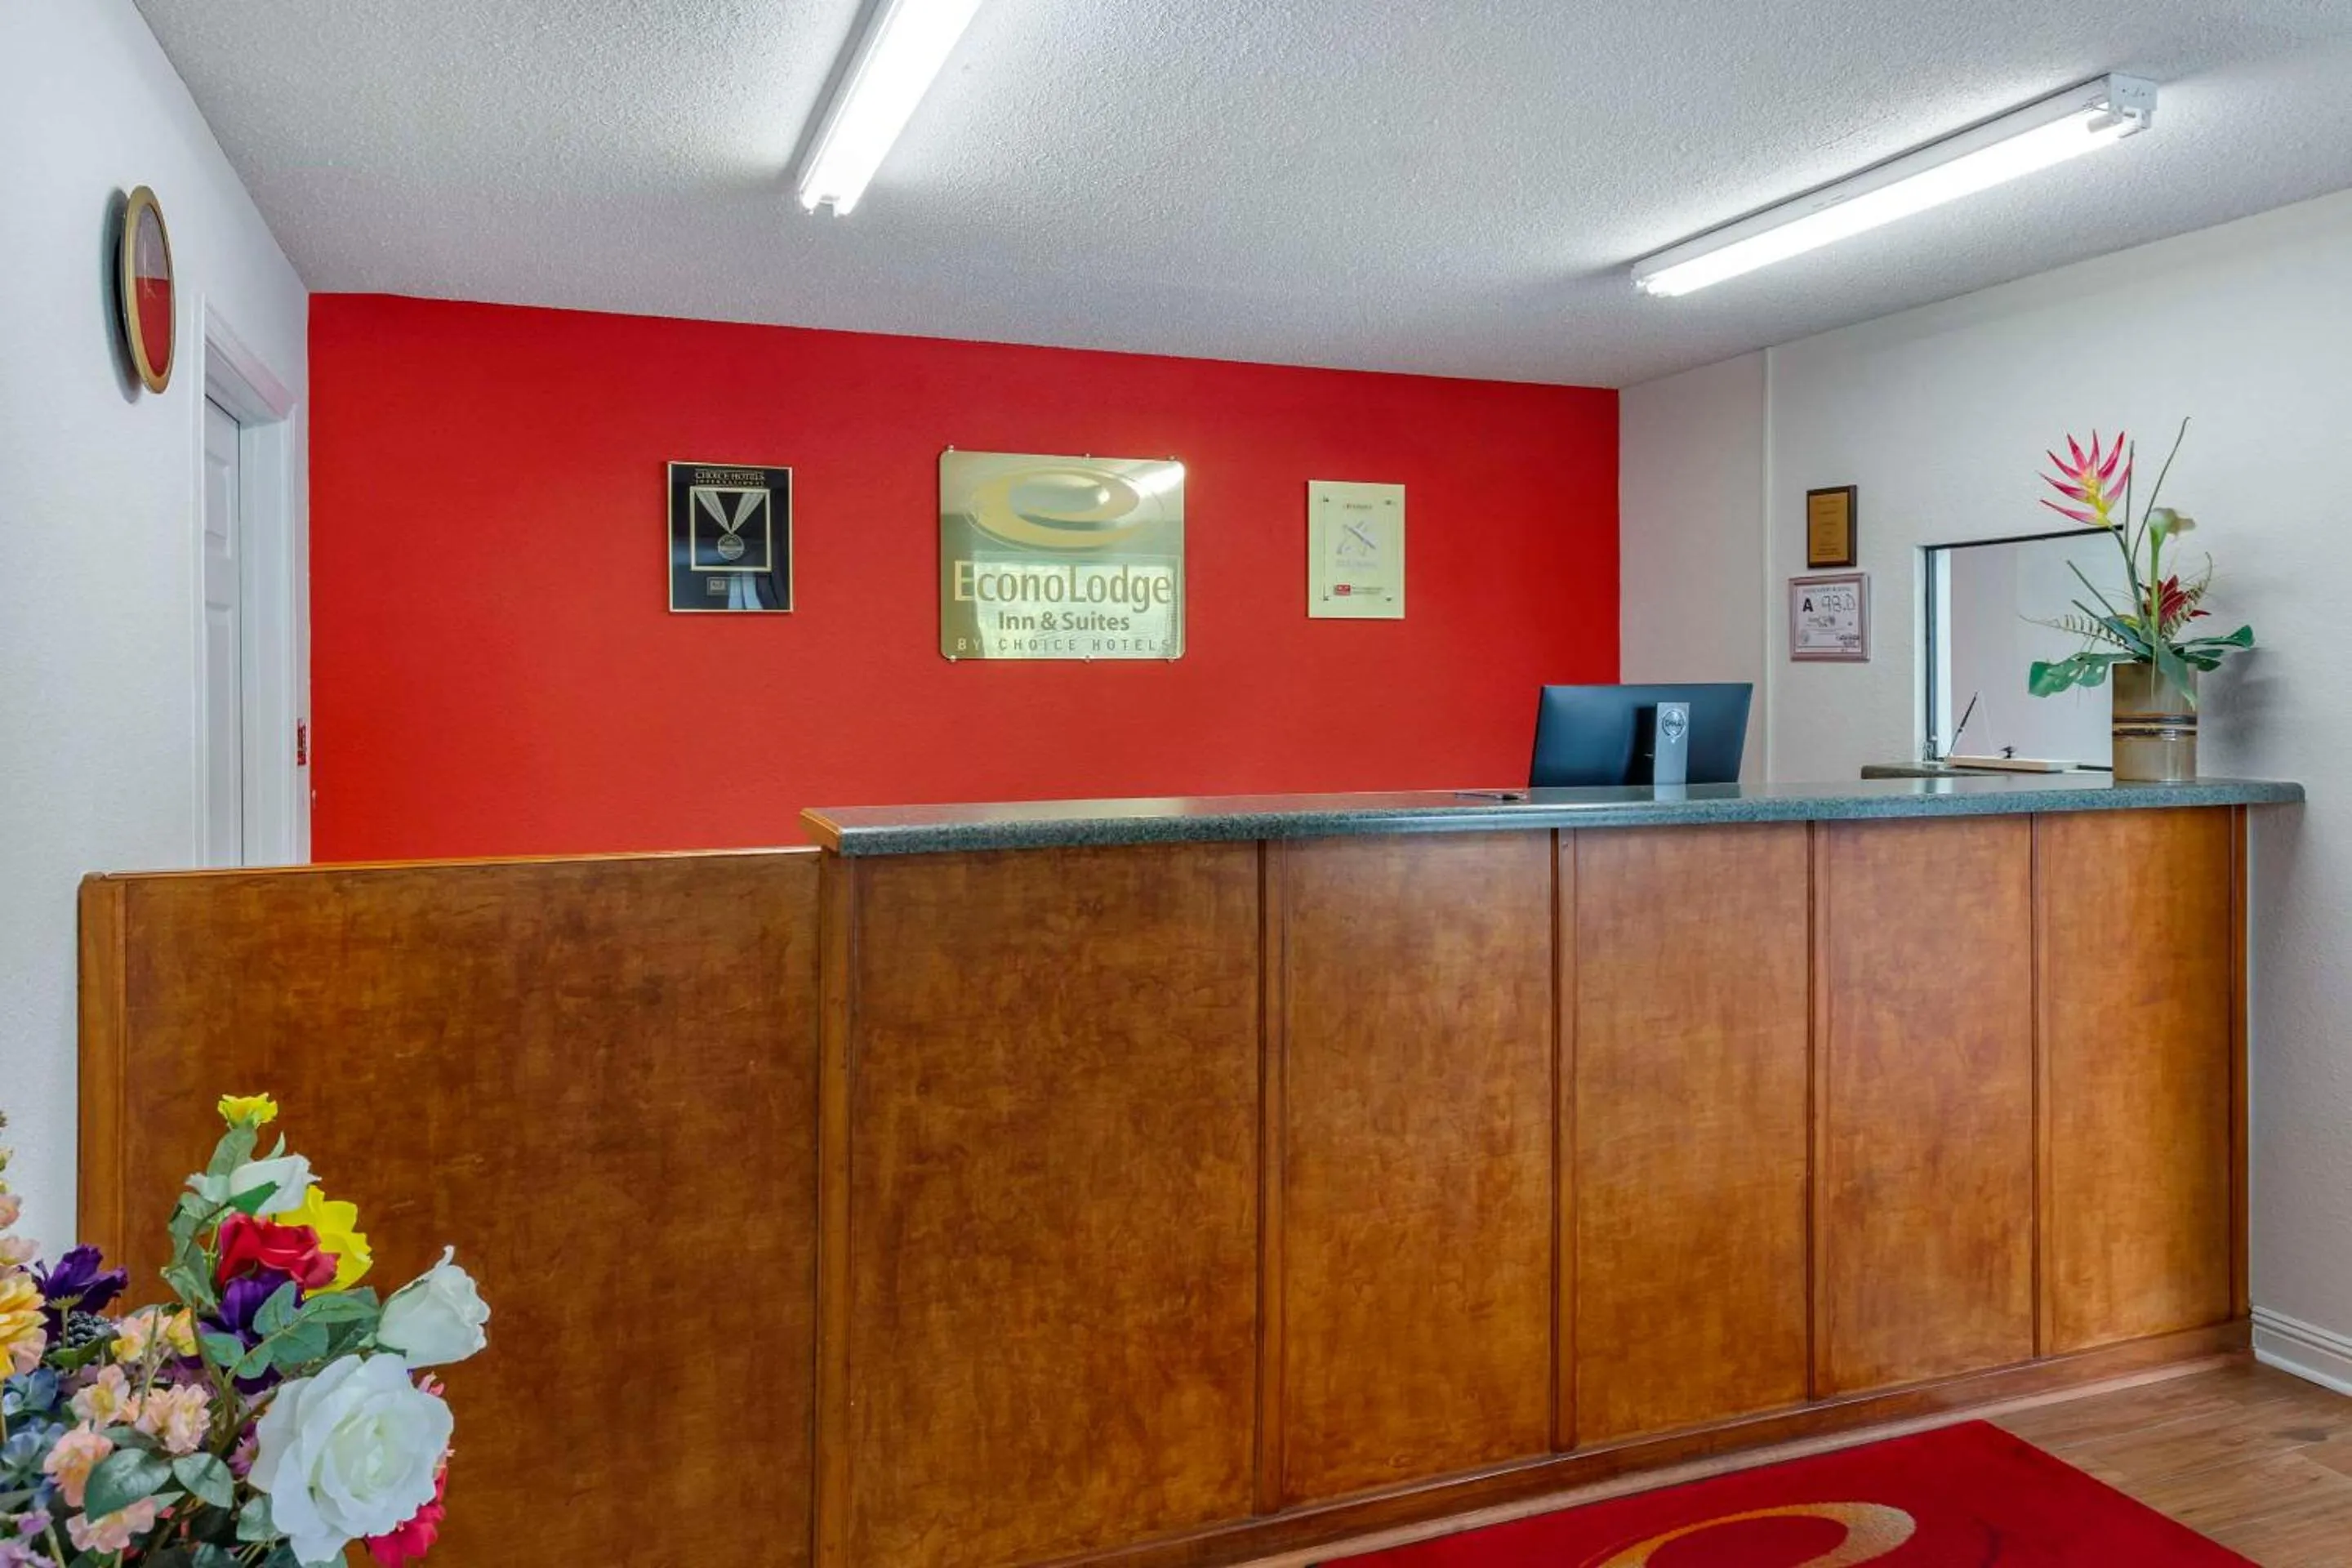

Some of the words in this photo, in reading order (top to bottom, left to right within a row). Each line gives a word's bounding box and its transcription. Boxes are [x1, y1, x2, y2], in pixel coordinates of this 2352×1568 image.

[954, 560, 1171, 612] EconoLodge
[1802, 598, 1814, 612] A
[998, 612, 1035, 630] Inn
[1040, 612, 1056, 631] &
[1061, 612, 1130, 631] Suites
[956, 638, 982, 651] BY
[998, 639, 1076, 652] CHOICE
[1092, 639, 1170, 652] HOTELS
